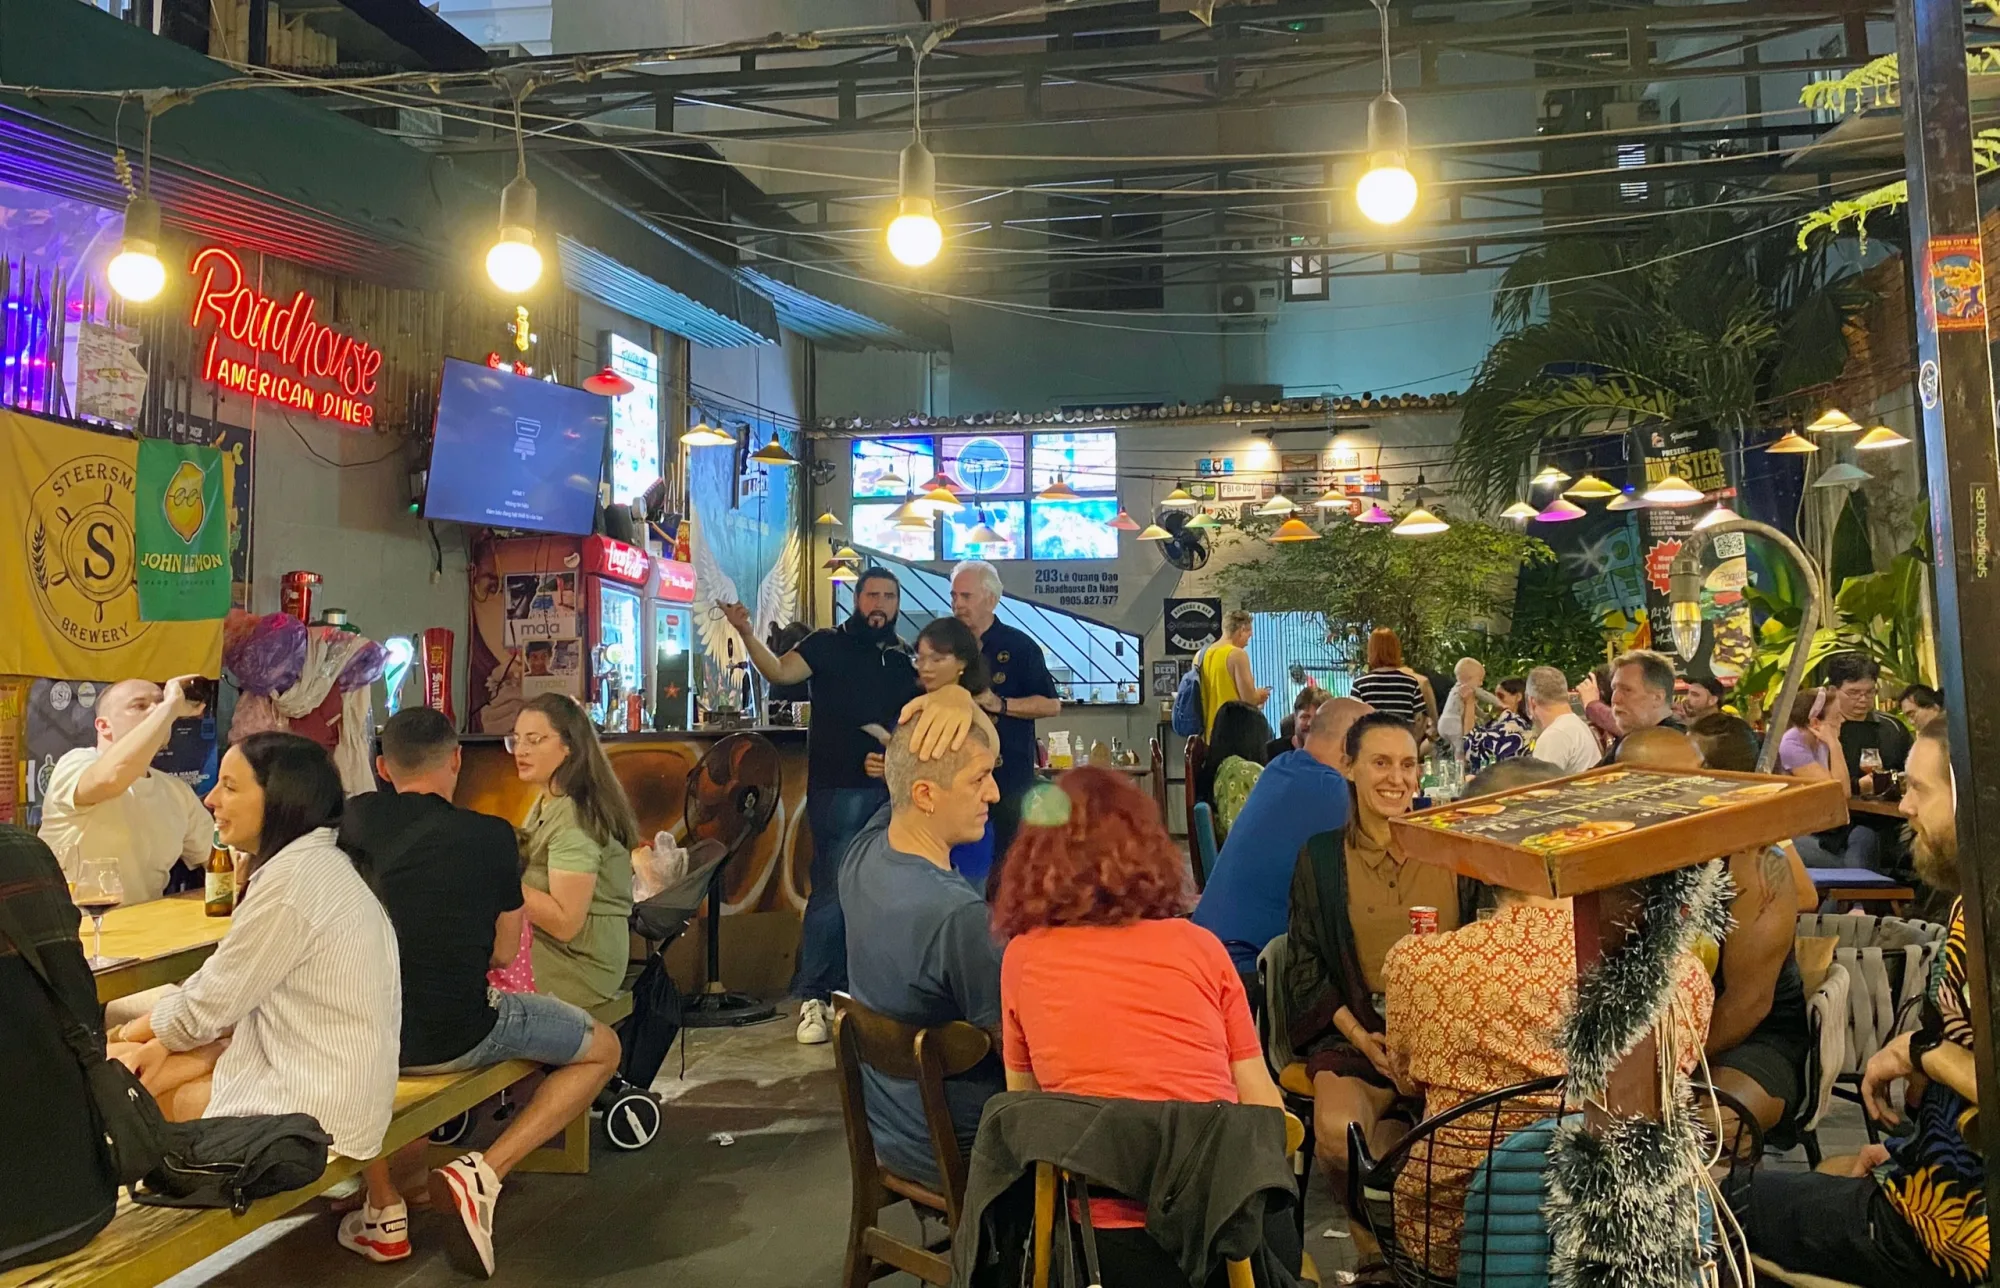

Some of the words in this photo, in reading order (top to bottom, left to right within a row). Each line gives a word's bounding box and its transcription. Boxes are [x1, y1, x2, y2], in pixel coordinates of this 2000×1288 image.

[190, 248, 382, 396] Roadhouse
[216, 358, 315, 410] AMERICAN
[320, 391, 374, 427] DINER
[52, 463, 136, 498] STEERSM
[1975, 487, 1988, 578] SPRINGROLLERS
[83, 521, 116, 581] S
[140, 553, 182, 573] JOHN
[183, 553, 224, 573] LEMON
[1034, 569, 1058, 583] 203
[1071, 572, 1100, 583] Quang
[1059, 595, 1119, 606] 0905.827.577
[1087, 584, 1098, 593] Da
[1099, 584, 1119, 594] Nang
[61, 616, 130, 643] BREWERY
[521, 623, 560, 636] maa
[1154, 666, 1176, 675] BEER
[432, 672, 444, 696] San
